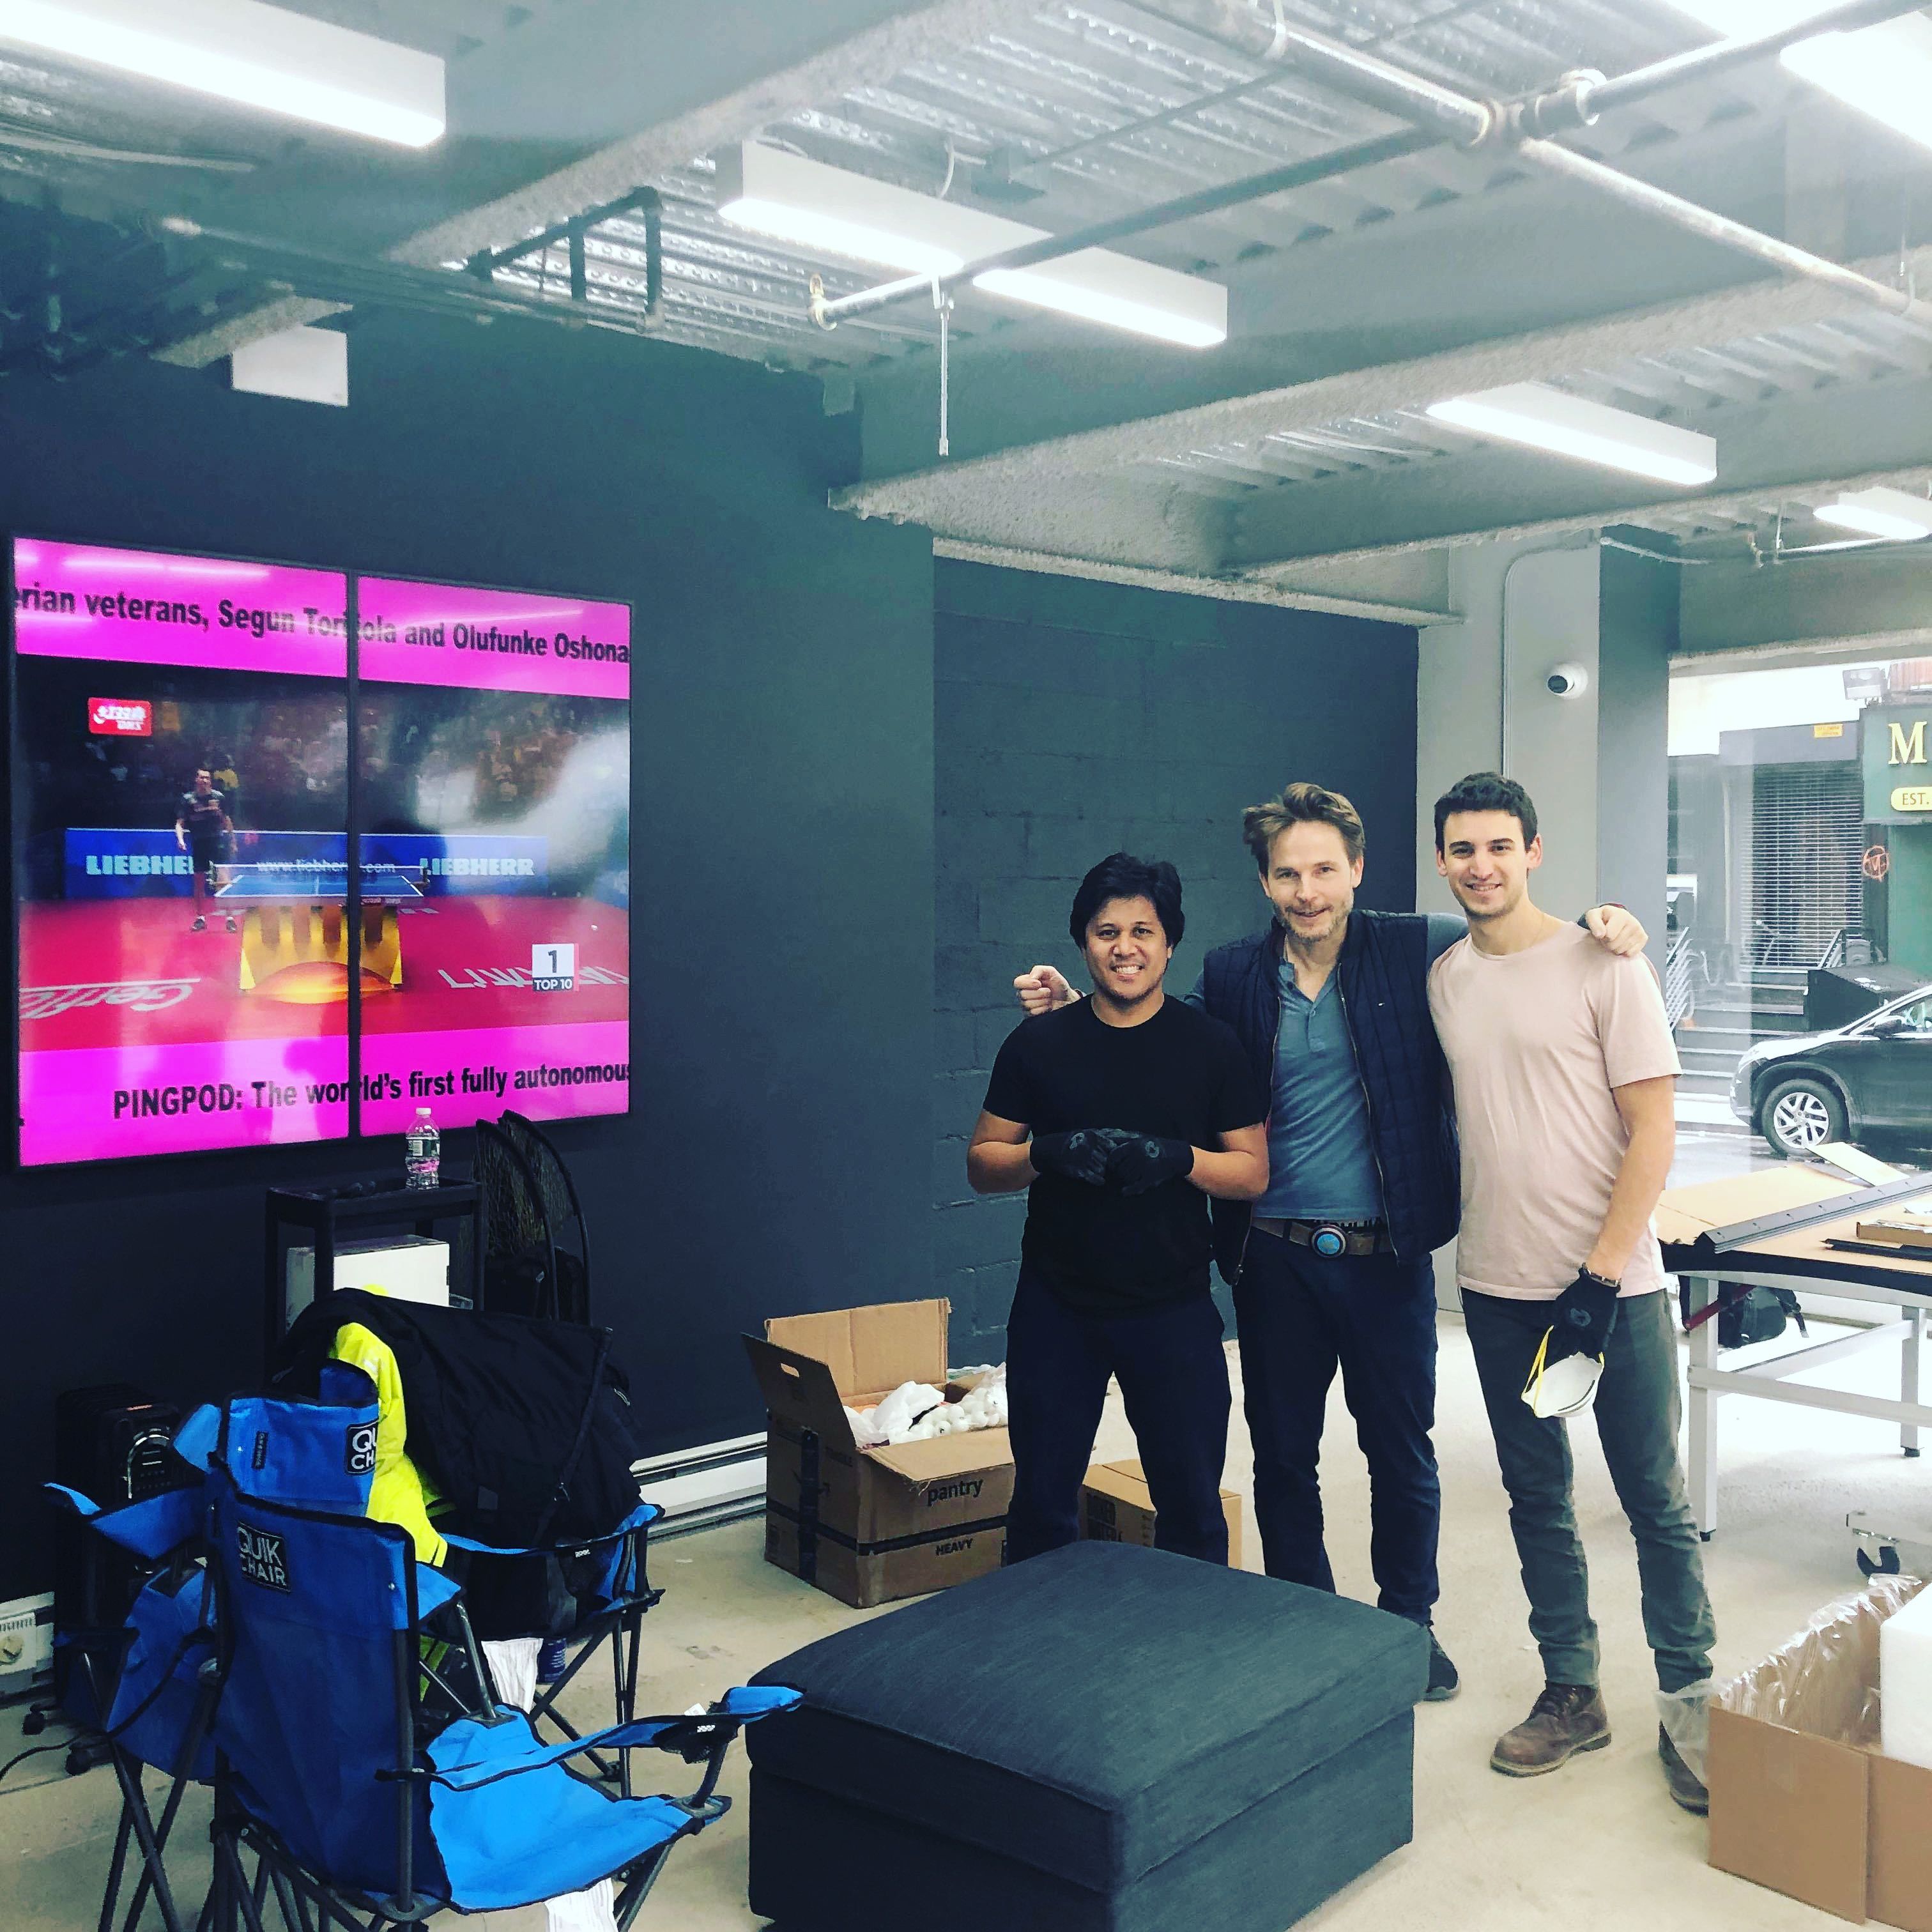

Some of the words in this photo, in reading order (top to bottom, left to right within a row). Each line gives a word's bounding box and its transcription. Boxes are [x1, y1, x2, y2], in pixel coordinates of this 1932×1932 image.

[85, 592, 210, 632] veterans,
[218, 599, 295, 638] Segun
[405, 623, 445, 647] and
[453, 623, 548, 656] Olufunke
[554, 632, 629, 663] Oshona
[1902, 792, 1929, 805] EST.
[548, 950, 557, 973] 1
[534, 979, 558, 990] TOP
[560, 978, 573, 990] 10
[114, 1083, 243, 1119] PINGPOD:
[251, 1080, 296, 1108] The
[409, 1070, 454, 1098] first
[461, 1066, 507, 1098] fully
[928, 1479, 984, 1506] pantry
[935, 1538, 974, 1556] HEAVY
